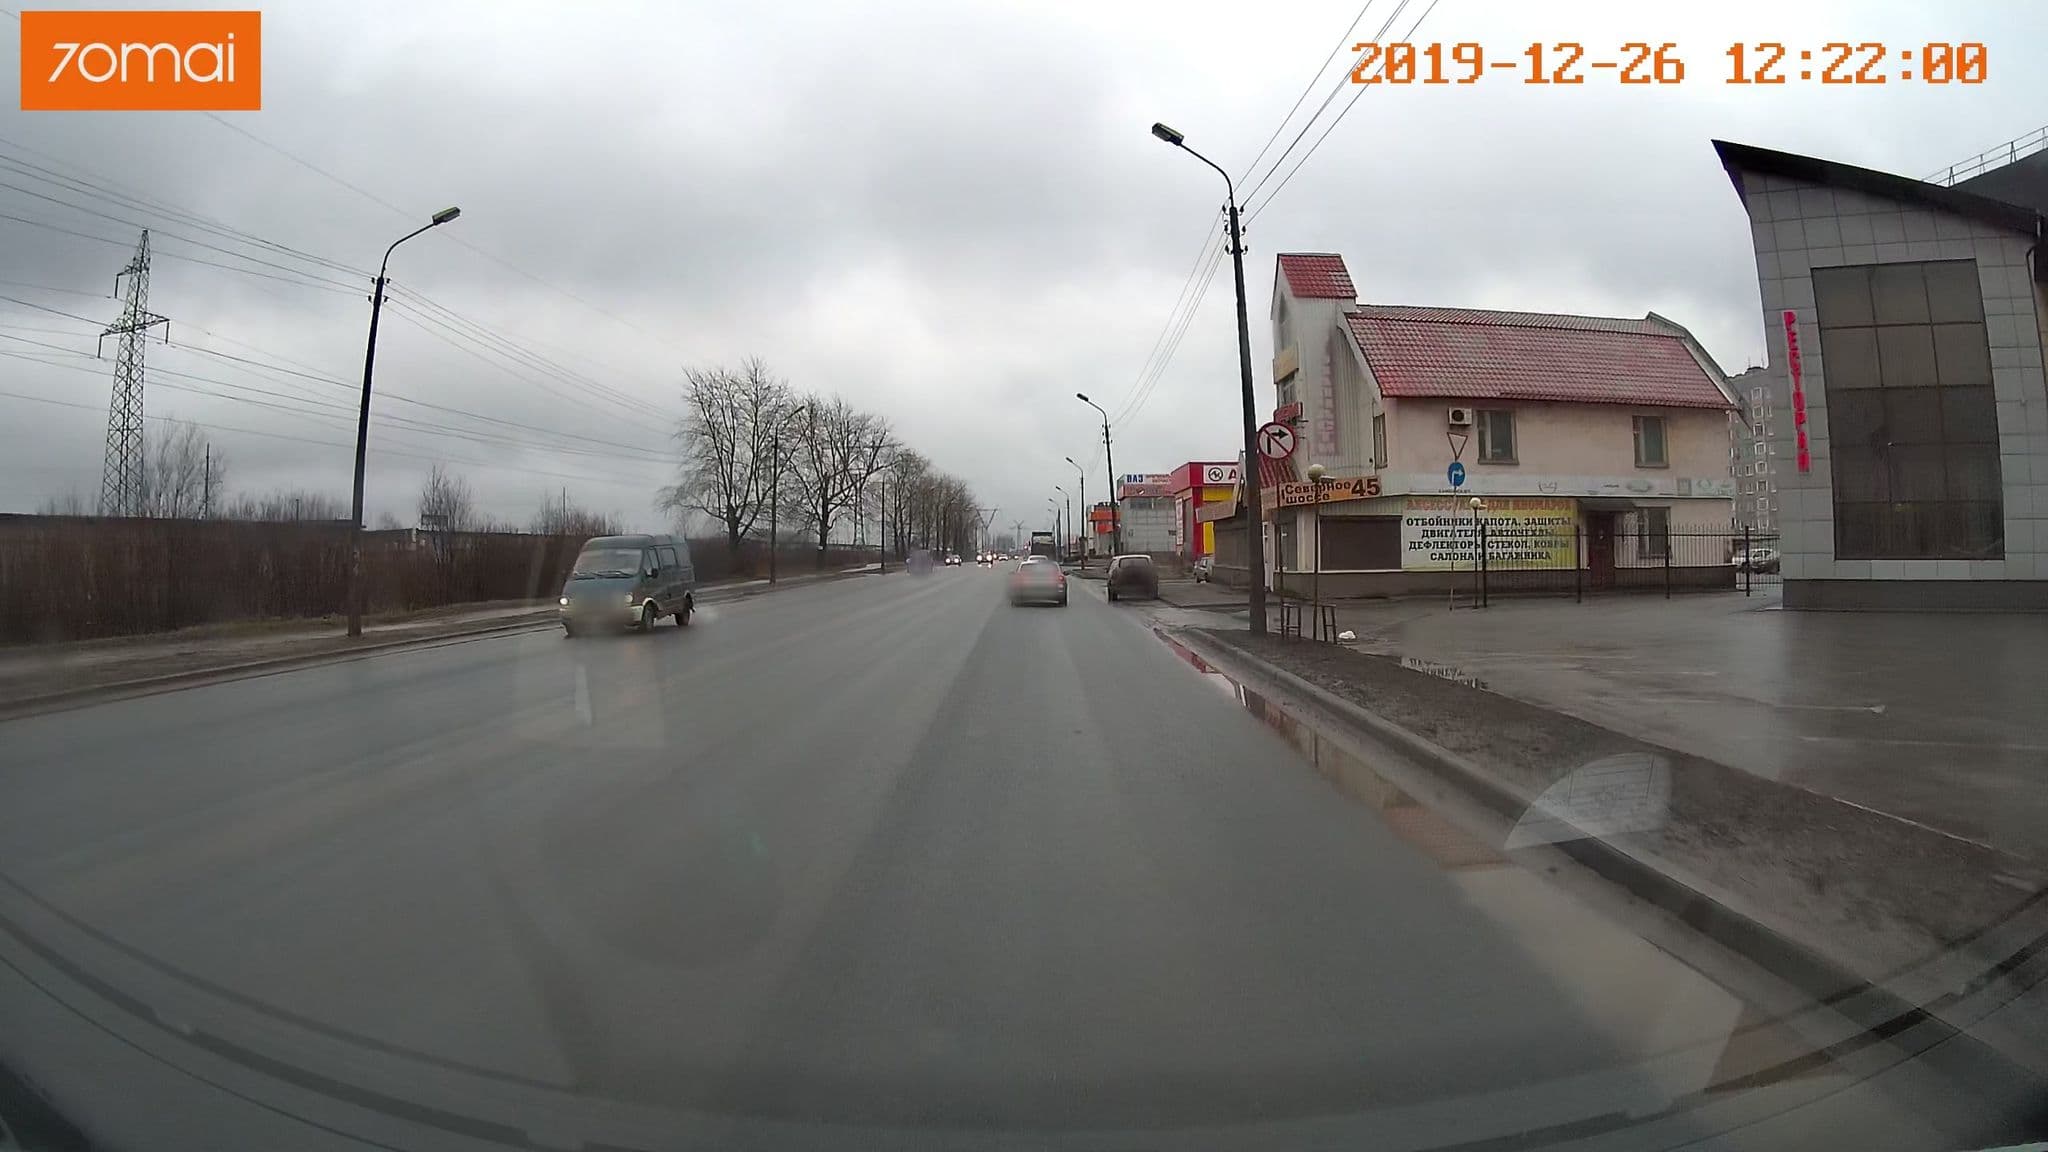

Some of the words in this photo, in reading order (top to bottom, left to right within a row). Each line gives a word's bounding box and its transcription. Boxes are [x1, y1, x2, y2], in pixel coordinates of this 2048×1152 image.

[1351, 477, 1381, 497] 45
[1405, 515, 1474, 528] ОТБОЙНИКИ
[1429, 551, 1475, 561] САЛОНА
[1488, 551, 1552, 561] БАГАЖНИКА
